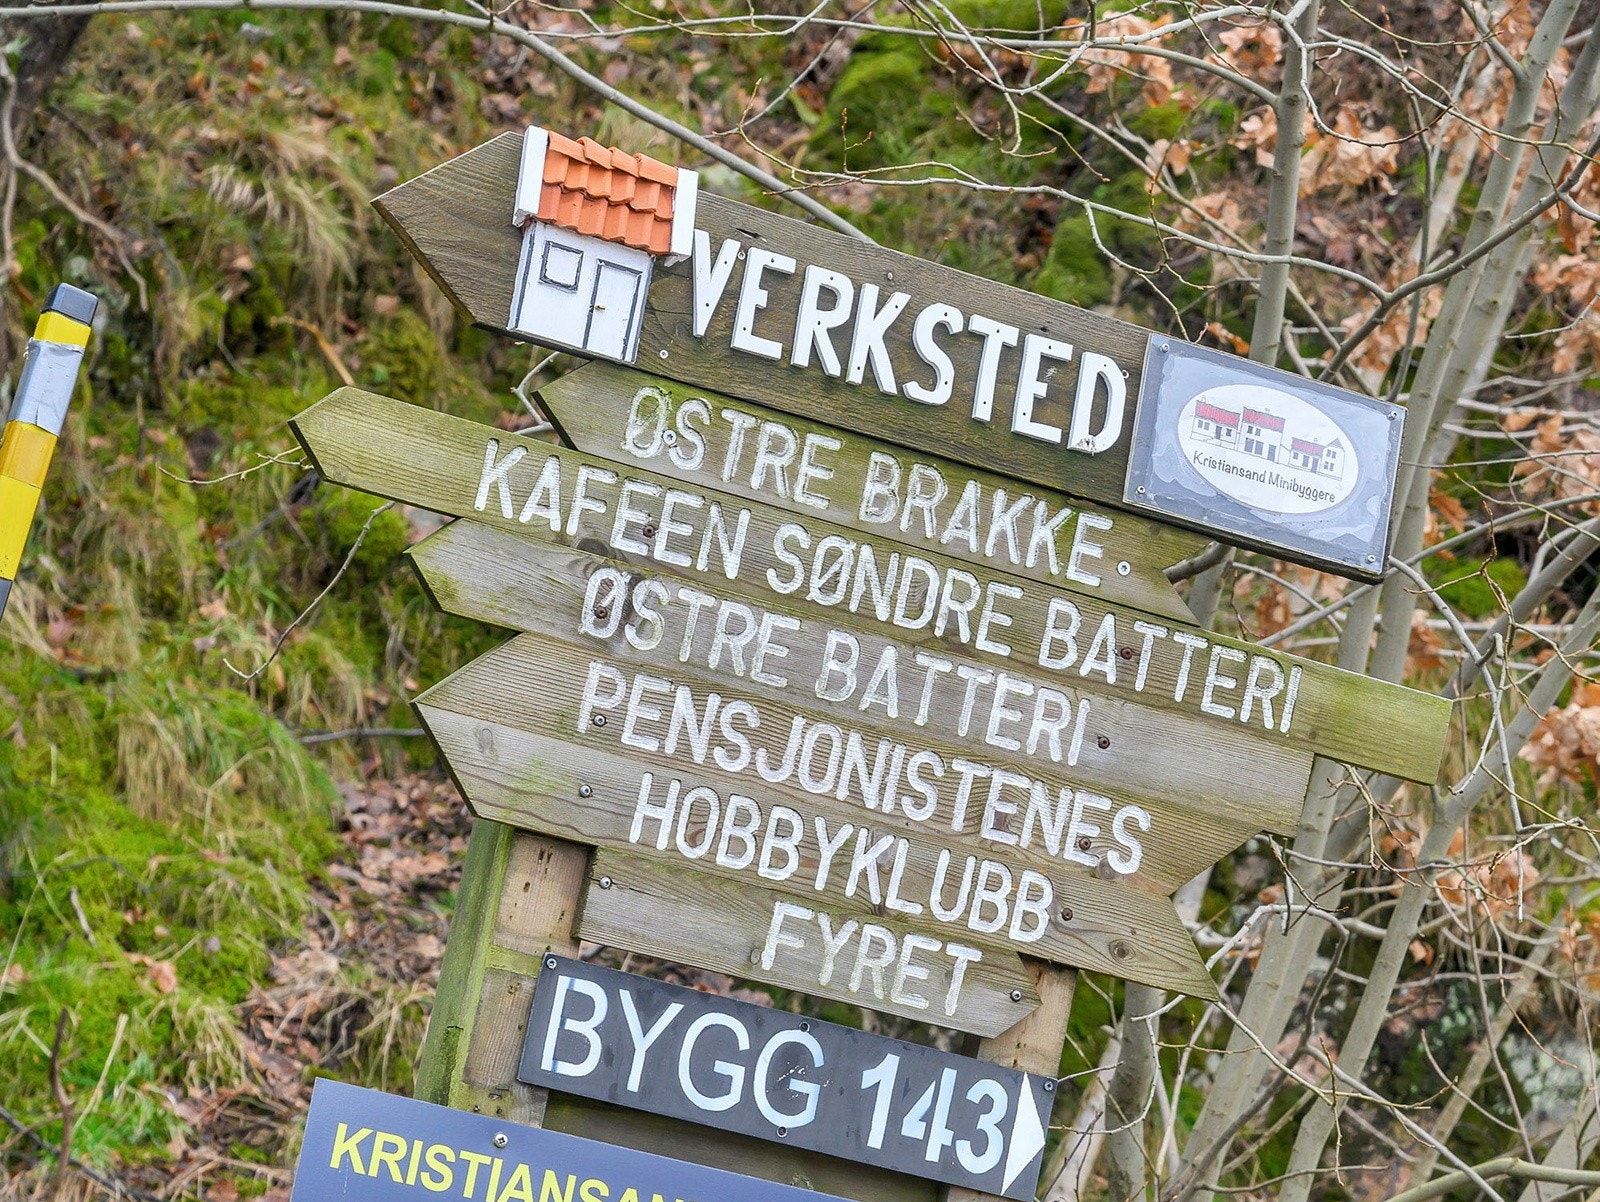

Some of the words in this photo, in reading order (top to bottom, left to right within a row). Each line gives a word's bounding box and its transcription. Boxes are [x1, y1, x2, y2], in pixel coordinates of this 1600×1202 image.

[691, 228, 1127, 456] VERKSTED
[622, 386, 842, 509] ØSTRE
[858, 450, 1113, 587] BRAKKE
[1193, 451, 1265, 483] Kristiansand
[1268, 471, 1335, 503] Minibyggere
[474, 438, 750, 580] KAFEEN
[766, 524, 1024, 656] SØNDRE
[1038, 597, 1302, 733] BATTERI
[578, 567, 801, 688] ØSTRE
[814, 629, 1091, 767] BATTERI
[577, 661, 1151, 875] PENSJONISTENES
[629, 772, 1053, 942] HOBBYKLUBB
[761, 901, 982, 1016] FYRET
[540, 975, 825, 1128] BYGG
[861, 1053, 1008, 1174] 143
